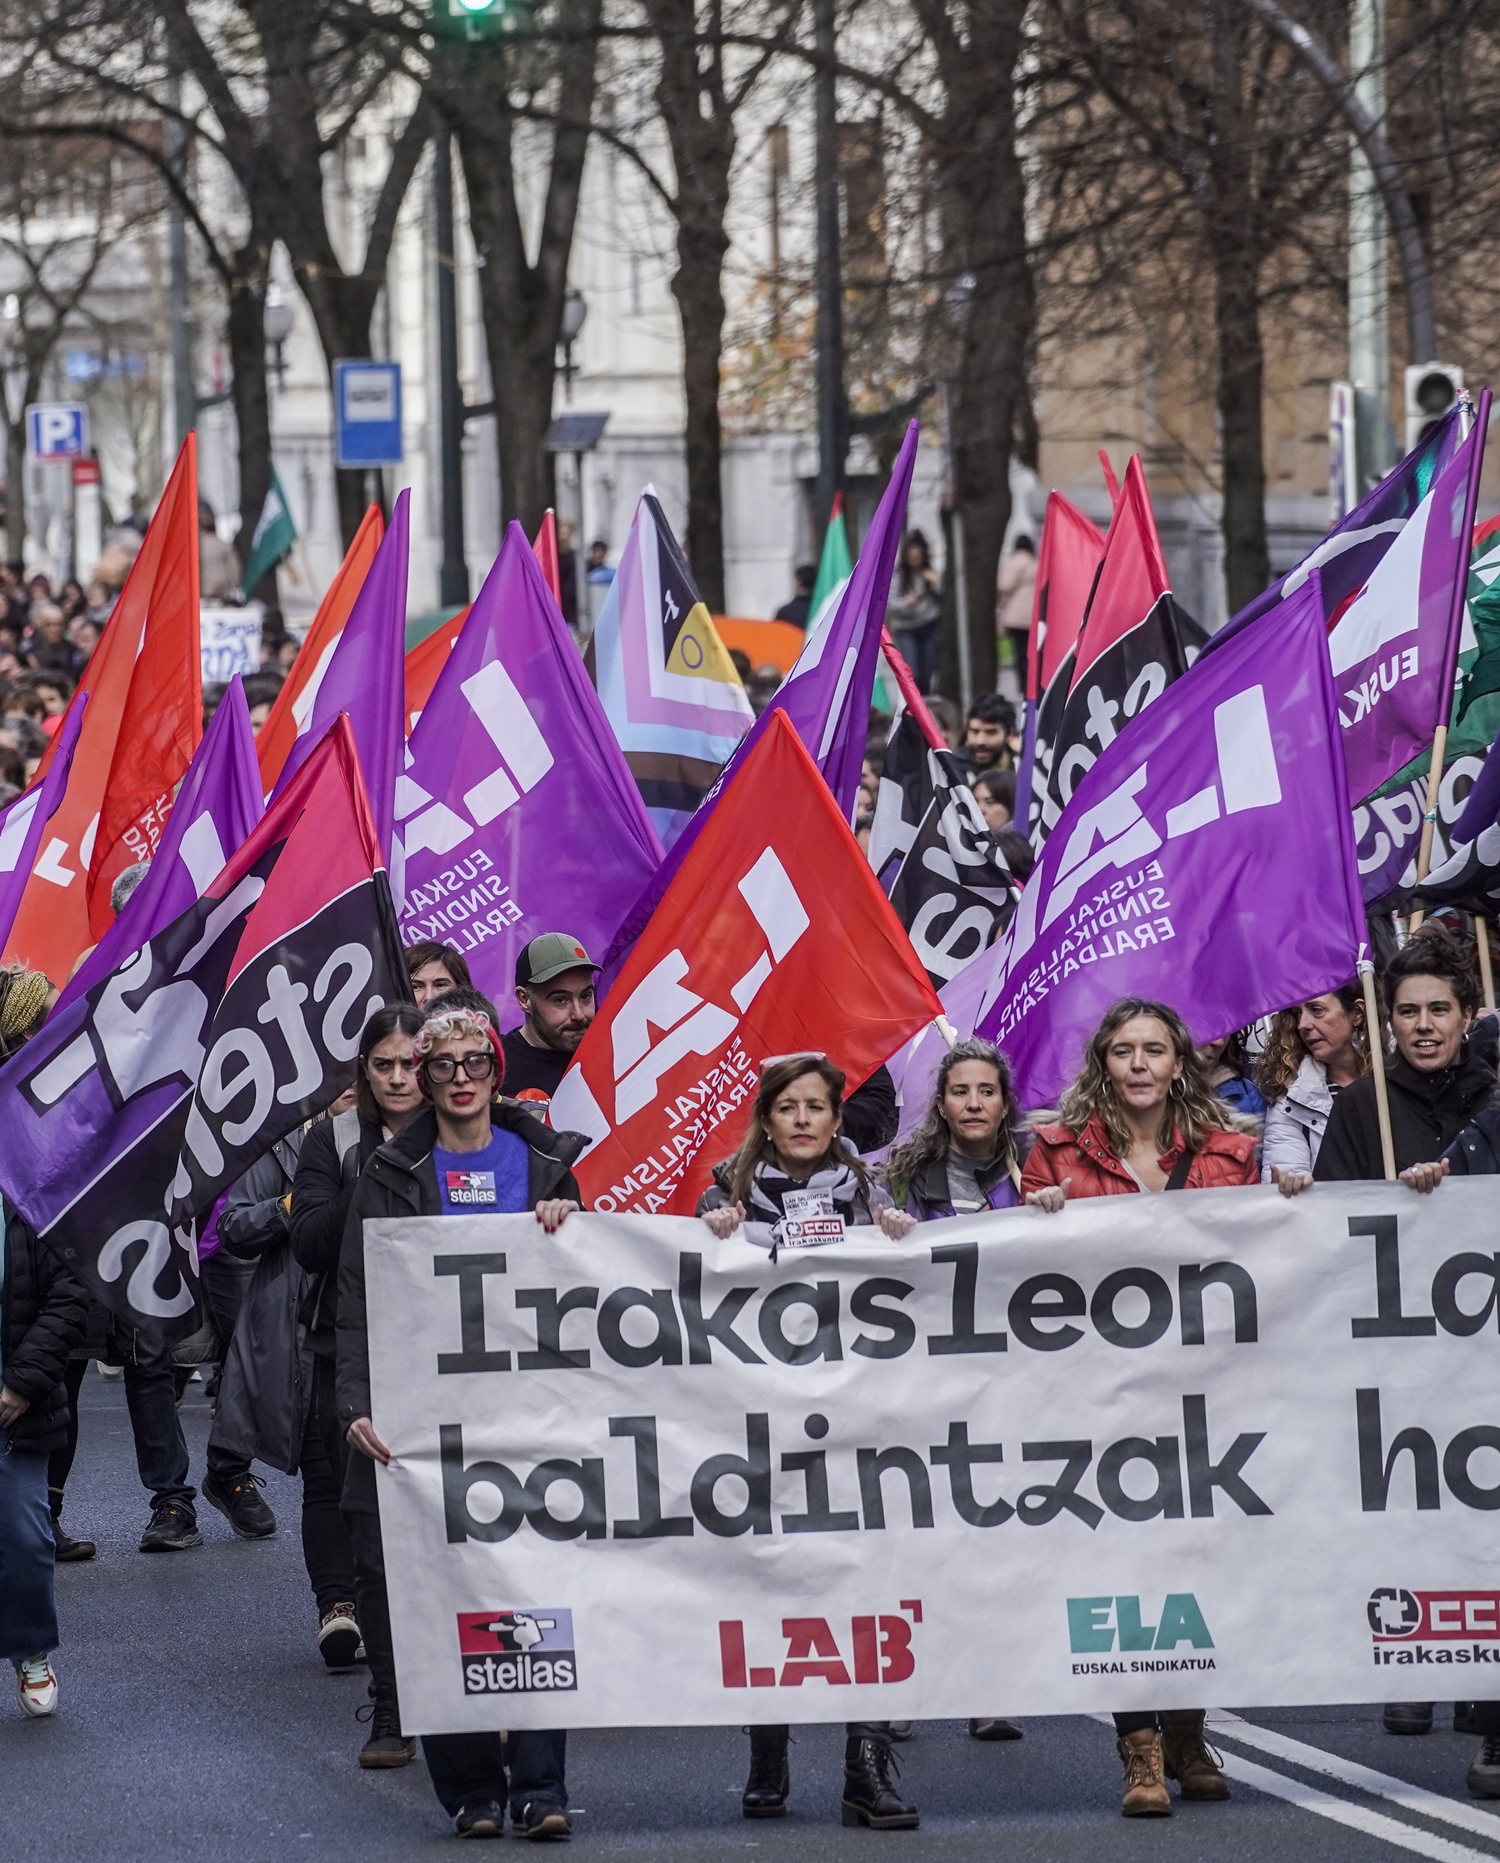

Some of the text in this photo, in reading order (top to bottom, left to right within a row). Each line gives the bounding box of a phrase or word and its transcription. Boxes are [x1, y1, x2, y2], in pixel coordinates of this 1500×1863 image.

[41, 408, 75, 455] P
[804, 1221, 841, 1235] CCOO
[433, 1214, 1500, 1375] Irakasleon la
[439, 1394, 1274, 1544] baldintzak
[1066, 1593, 1215, 1654] ELA
[465, 1655, 575, 1692] steilas
[719, 1614, 916, 1688] LAB
[1071, 1657, 1217, 1676] EUSKAL SINDIKATUA
[1373, 1644, 1500, 1666] irakasku
